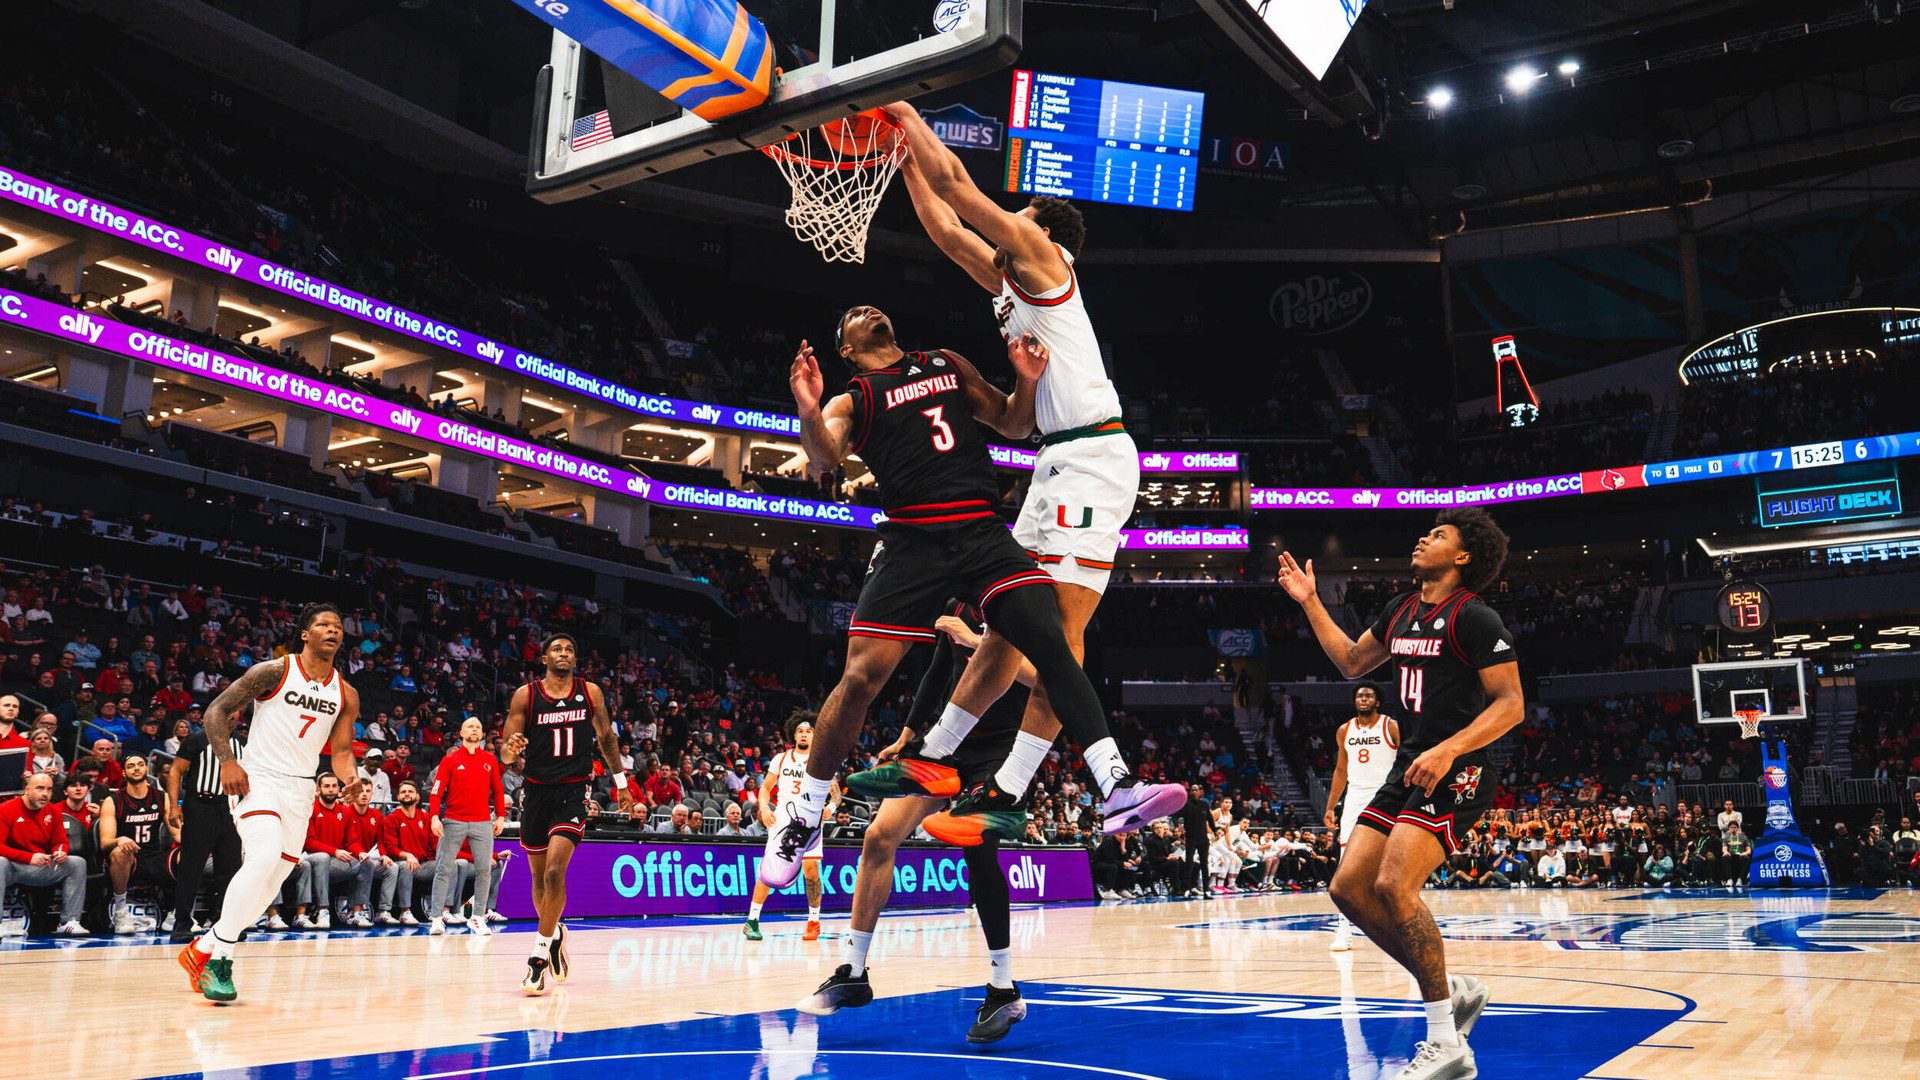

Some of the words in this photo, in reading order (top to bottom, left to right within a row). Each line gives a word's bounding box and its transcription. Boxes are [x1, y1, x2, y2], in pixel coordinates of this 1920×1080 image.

[939, 2, 967, 19] ACC
[1037, 74, 1076, 86] LOUISVILLE
[922, 117, 993, 145] OWE'S
[1007, 137, 1022, 193] HURRICANES
[0, 171, 60, 208] Bank
[63, 199, 88, 217] of
[91, 204, 128, 230] the
[131, 220, 185, 252] ACC.
[206, 247, 242, 274] ally
[1304, 274, 1341, 303] Dr
[259, 265, 326, 301] Official
[328, 288, 373, 317] Bank
[375, 307, 392, 322] of
[394, 311, 421, 332] the
[423, 322, 462, 348] ACC.
[1273, 281, 1365, 329] Pepper
[1825, 299, 1851, 311] BAR
[60, 314, 104, 343] ally
[477, 342, 504, 364] ally
[129, 333, 209, 370] Official
[212, 356, 264, 386] Bank
[267, 374, 288, 392] of
[290, 379, 321, 401] the
[324, 389, 370, 417] ACC.
[516, 354, 565, 382] Official
[567, 371, 600, 394] Bank
[601, 385, 615, 399] of
[616, 388, 637, 406] the
[638, 396, 675, 415] ACC.
[885, 373, 959, 411] LOUISVILLE
[391, 409, 421, 433] ally
[692, 405, 721, 424] ally
[734, 411, 789, 431] Official
[920, 404, 956, 453] 3
[439, 422, 495, 451] Official
[498, 438, 535, 463] Bank
[537, 452, 552, 467] of
[554, 455, 577, 474] the
[579, 463, 612, 485] ACC.
[1143, 454, 1170, 470] ally
[1183, 454, 1237, 468] Official
[1771, 452, 1783, 469] 7
[1793, 446, 1843, 466] 15:25
[1855, 442, 1868, 459] 6
[1651, 470, 1662, 478] TO
[1669, 467, 1676, 477] 4
[1684, 464, 1702, 474] FOULS
[1712, 461, 1719, 472] 0
[627, 477, 650, 497] ally
[1266, 491, 1293, 505] the
[1295, 491, 1334, 505] ACC.
[1352, 490, 1380, 507] ally
[1397, 490, 1453, 505] Official
[1456, 487, 1496, 503] Bank
[1498, 483, 1513, 499] of
[1516, 482, 1543, 496] the
[665, 486, 723, 506] Official
[726, 494, 767, 511] Bank
[769, 499, 786, 513] of
[787, 501, 814, 516] the
[815, 505, 854, 521] ACC.
[1768, 496, 1835, 517] FLIGHT
[1839, 490, 1892, 510] DECK
[1057, 504, 1094, 529] U
[1145, 531, 1200, 545] Official
[1202, 532, 1241, 545] Bank
[1729, 591, 1761, 606] 15:24
[1738, 605, 1761, 627] 13
[1390, 637, 1443, 656] LOUISVILLE
[1400, 665, 1424, 714] 14
[284, 690, 337, 716] CANES
[299, 714, 316, 739] 7
[537, 707, 588, 727] LOUISVILLE
[553, 728, 575, 758] 11
[1348, 736, 1381, 746] CANES
[1358, 749, 1370, 764] 8
[782, 768, 804, 779] CAN
[791, 780, 802, 795] 3
[125, 812, 160, 823] LOUISVILLE
[135, 824, 152, 844] 15
[612, 850, 748, 898] Official
[1009, 855, 1045, 897] ally
[1759, 868, 1811, 877] GREATNESS
